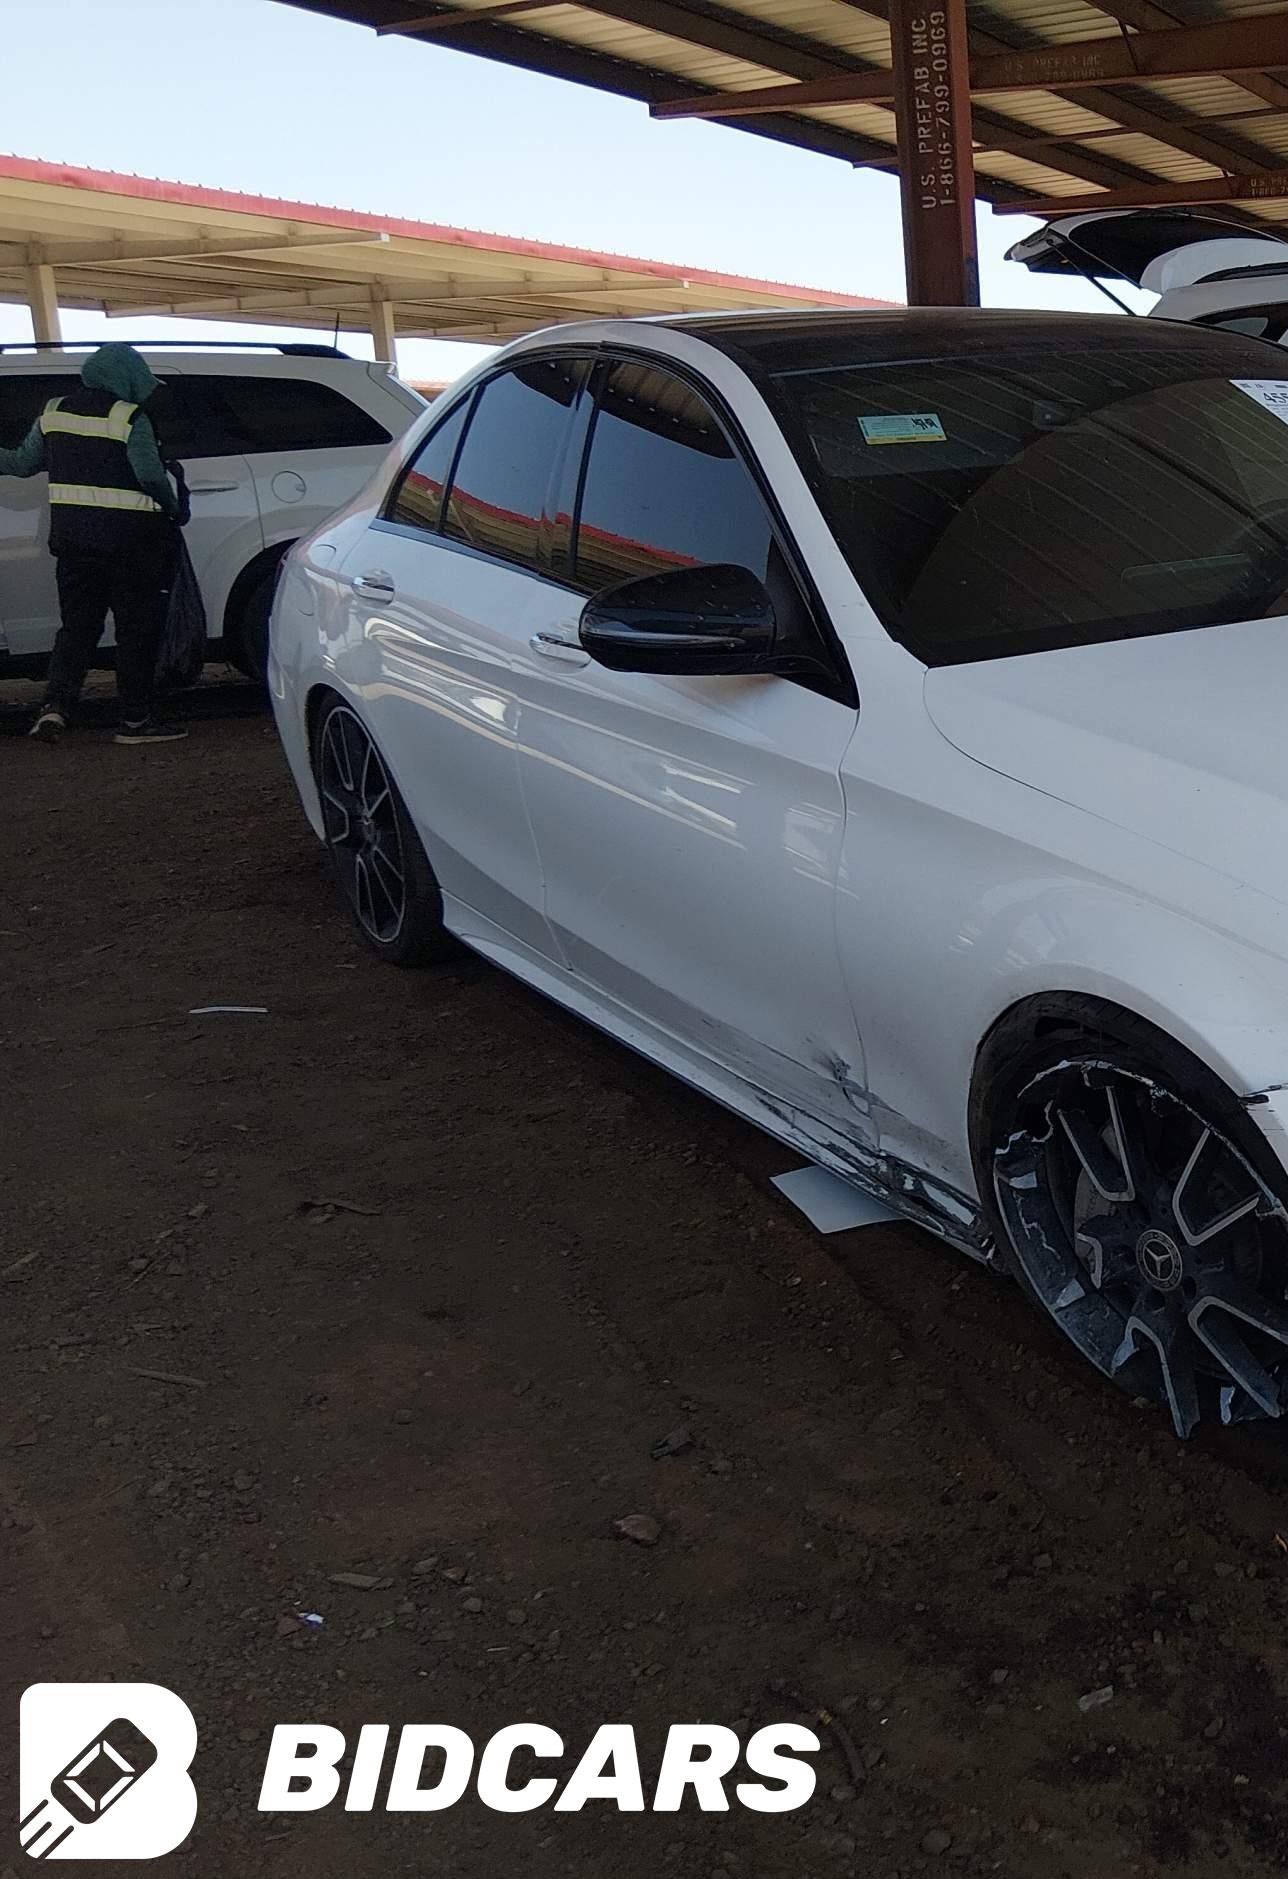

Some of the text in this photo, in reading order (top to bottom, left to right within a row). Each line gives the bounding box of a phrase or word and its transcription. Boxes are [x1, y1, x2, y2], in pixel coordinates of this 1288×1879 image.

[914, 66, 934, 154] PREFAB
[930, 10, 956, 206] 1-866-799-0969
[921, 166, 937, 209] U.S.
